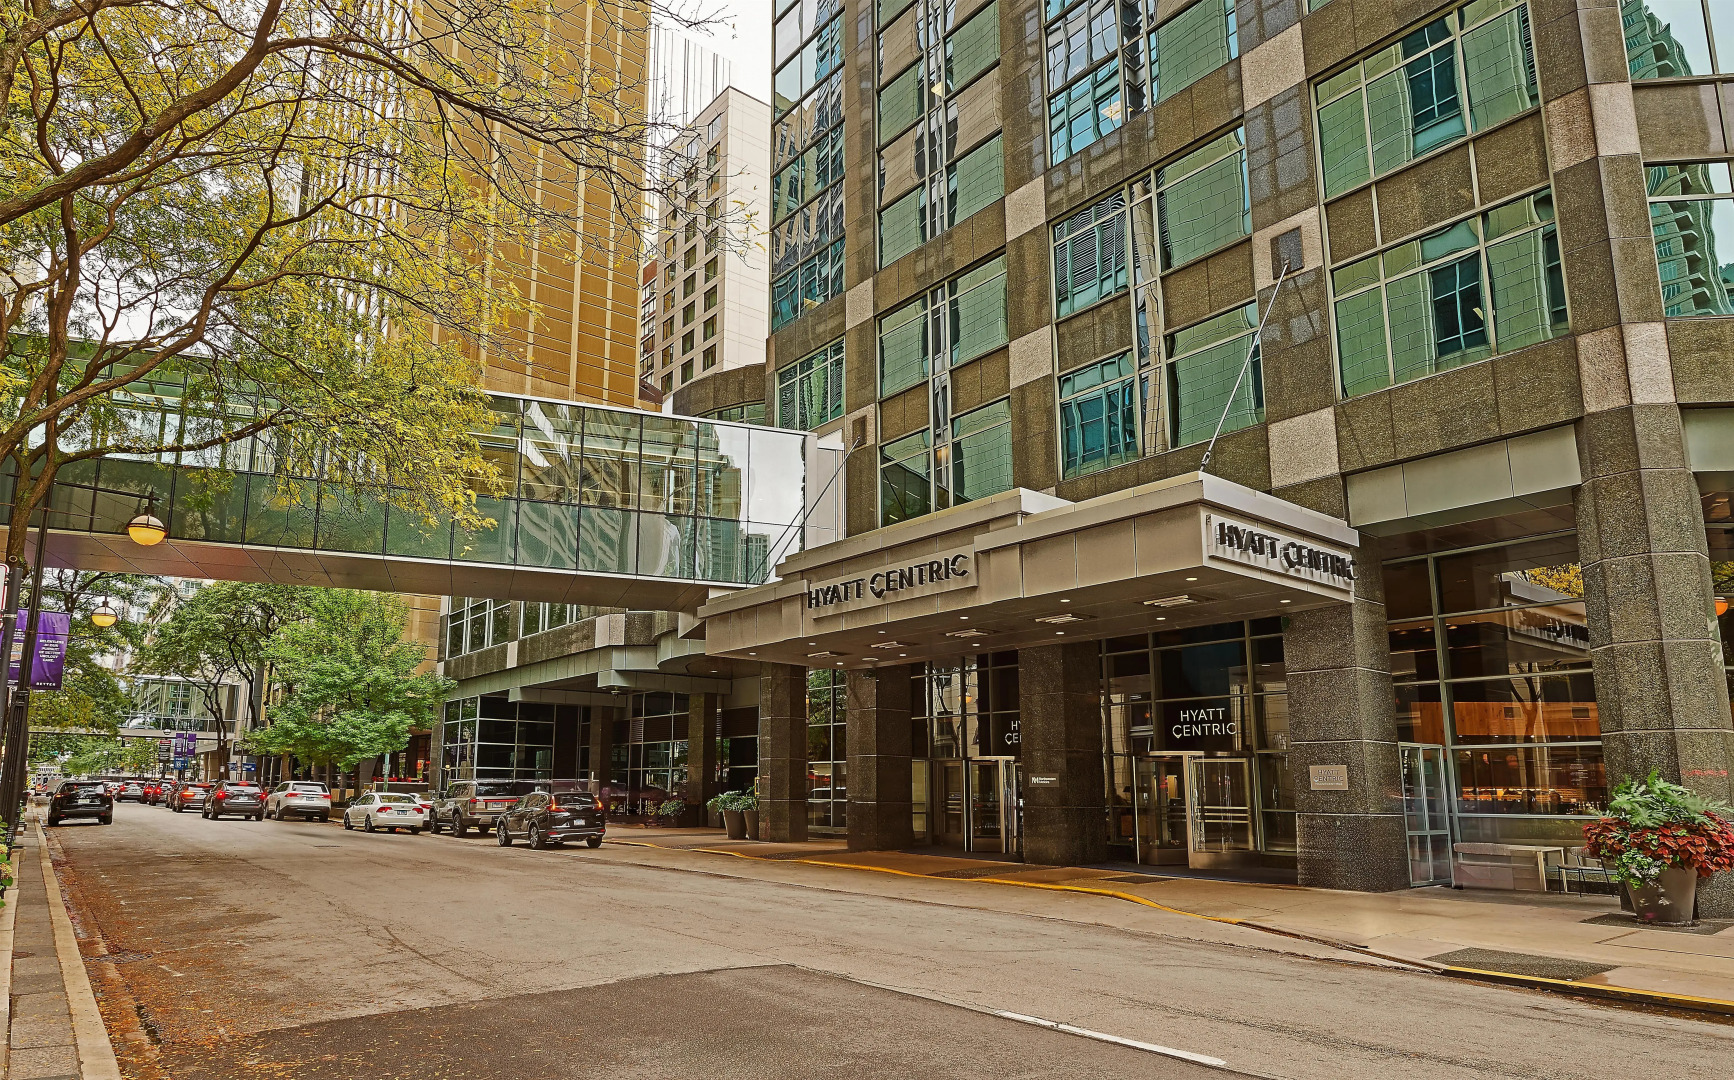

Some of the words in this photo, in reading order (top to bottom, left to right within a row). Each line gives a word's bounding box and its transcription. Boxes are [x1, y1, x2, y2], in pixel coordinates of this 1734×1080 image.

[1216, 522, 1281, 559] HYATT
[1280, 541, 1359, 581] CENTRIC
[807, 578, 866, 609] HYATT
[869, 554, 969, 598] CENTRIC
[1172, 722, 1237, 739] CENTRIC
[1180, 707, 1226, 722] HYATT
